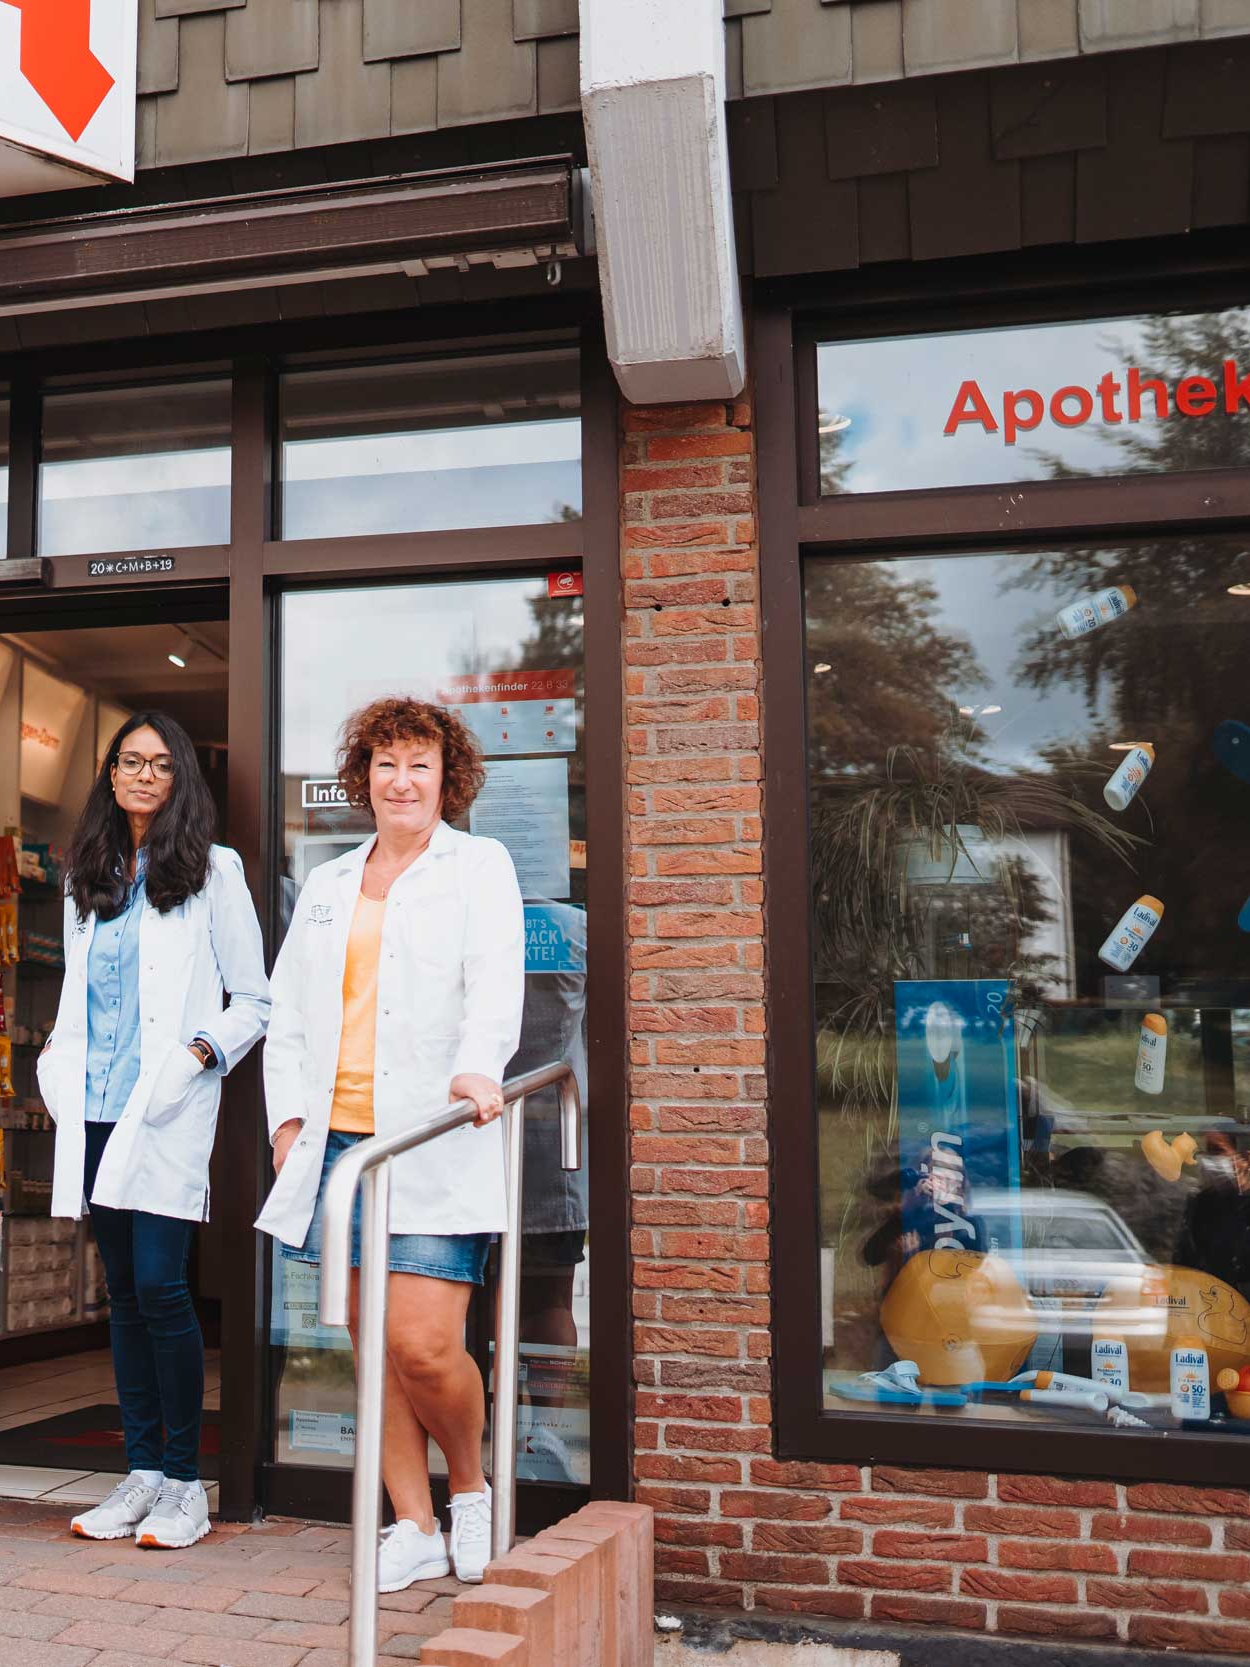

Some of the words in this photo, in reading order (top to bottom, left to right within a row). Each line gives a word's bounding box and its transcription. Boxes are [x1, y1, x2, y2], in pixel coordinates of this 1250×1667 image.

[1134, 907, 1158, 927] Ladival
[526, 919, 547, 928] BT'S
[1128, 941, 1139, 952] 30
[1095, 1343, 1122, 1355] Ladival
[1175, 1353, 1204, 1364] Ladival
